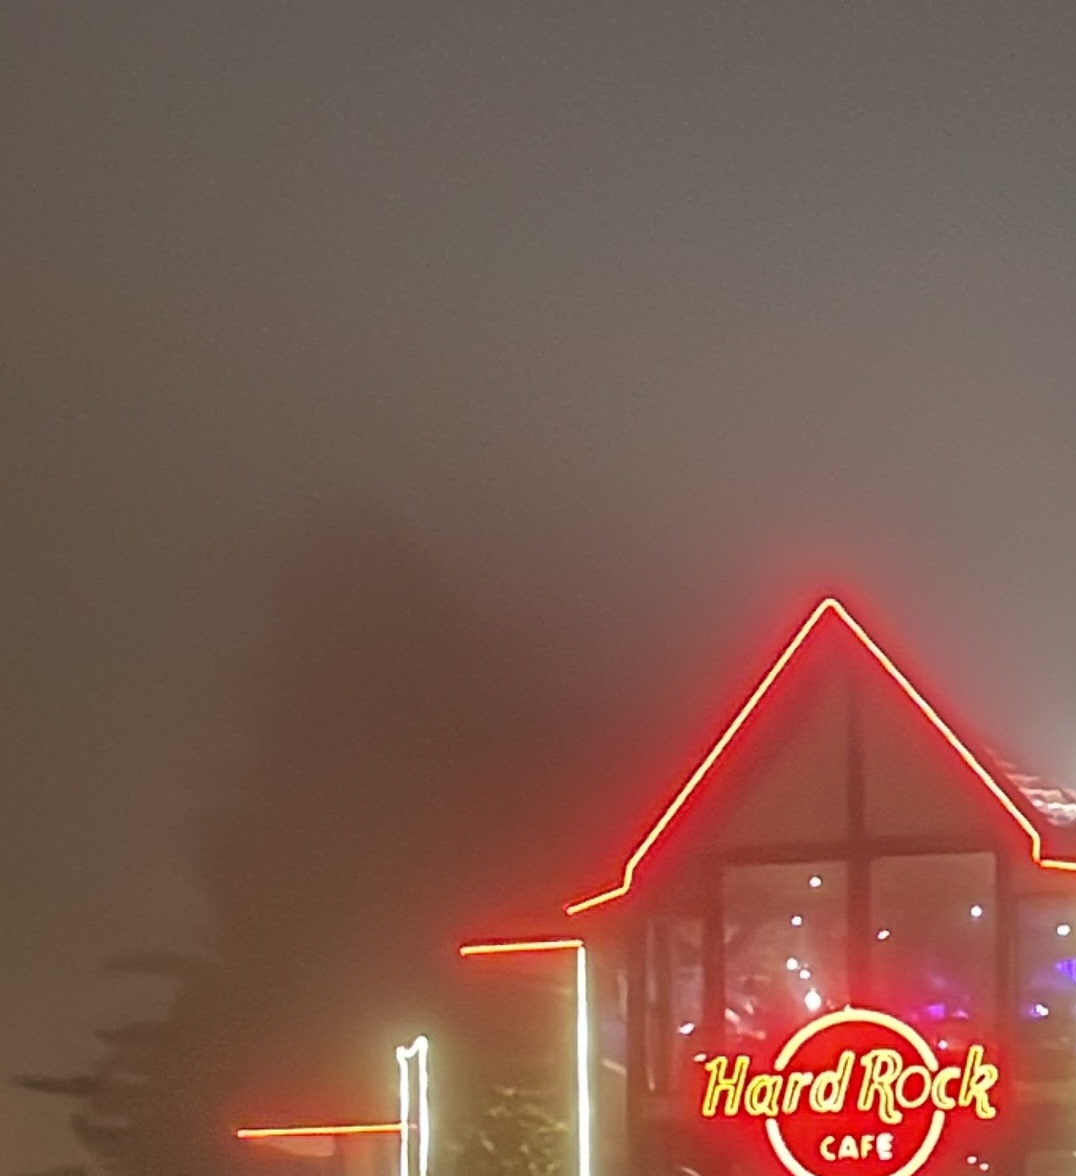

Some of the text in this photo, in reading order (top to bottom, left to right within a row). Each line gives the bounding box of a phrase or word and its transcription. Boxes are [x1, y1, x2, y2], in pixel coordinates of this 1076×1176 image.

[702, 1044, 999, 1125] Hard Rock
[819, 1132, 894, 1161] CAFE
